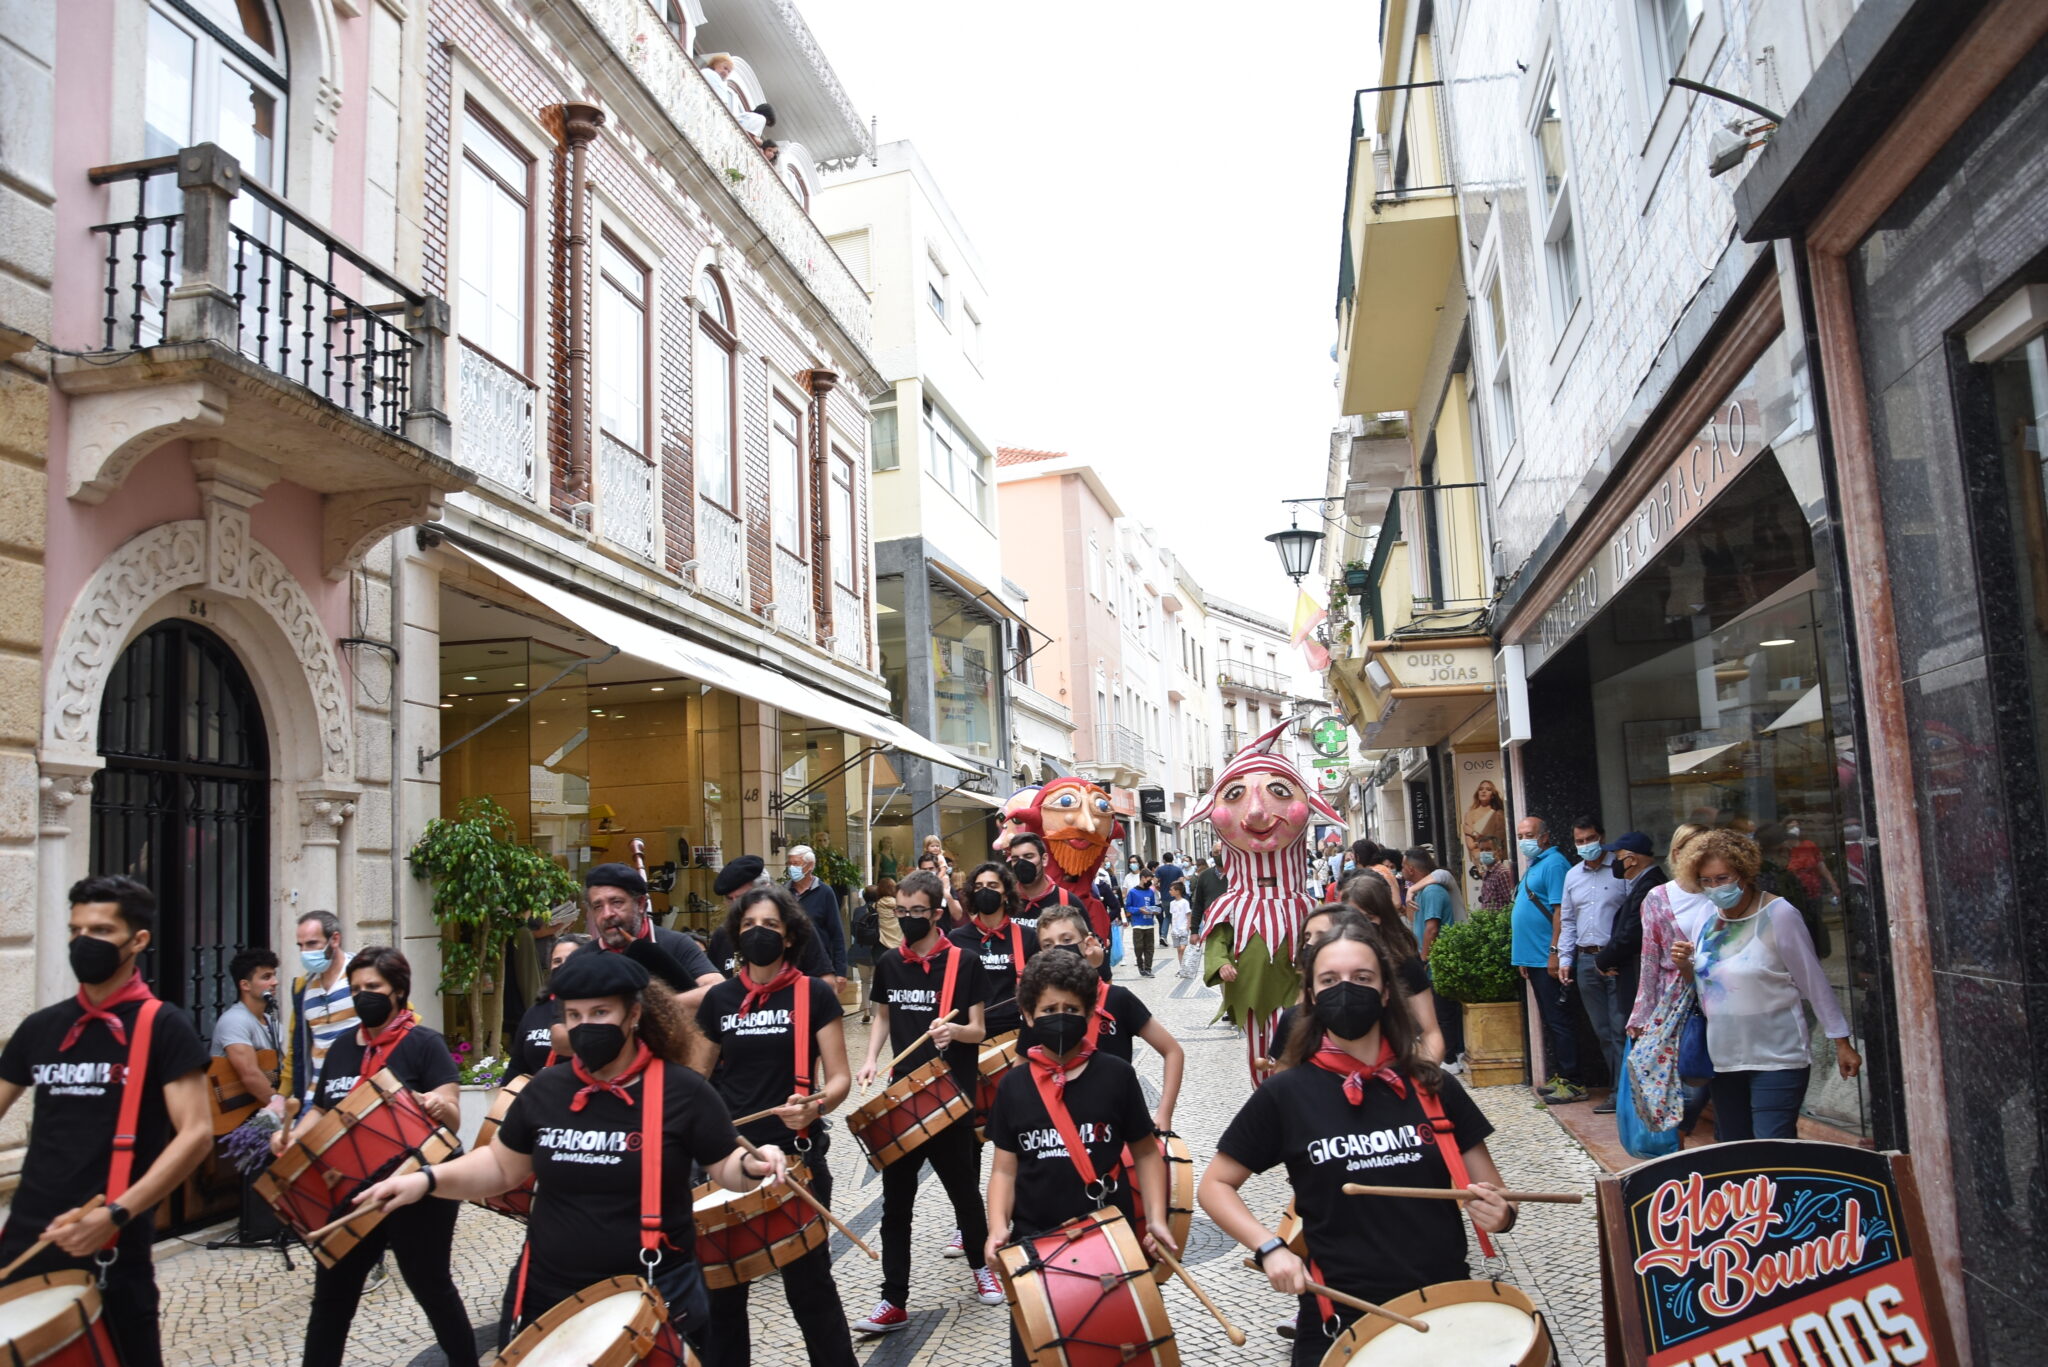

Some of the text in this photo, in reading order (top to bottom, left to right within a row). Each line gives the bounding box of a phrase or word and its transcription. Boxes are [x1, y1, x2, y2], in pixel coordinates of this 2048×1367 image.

[1538, 400, 1745, 656] MONTEIRO DECORAÇÃO
[189, 599, 207, 618] 54
[1406, 652, 1456, 667] OURO
[1429, 665, 1479, 681] JÓIAS
[1463, 760, 1495, 771] ONE
[743, 788, 760, 803] 48
[1633, 1171, 1784, 1276] Glory
[1698, 1197, 1866, 1317] Bound
